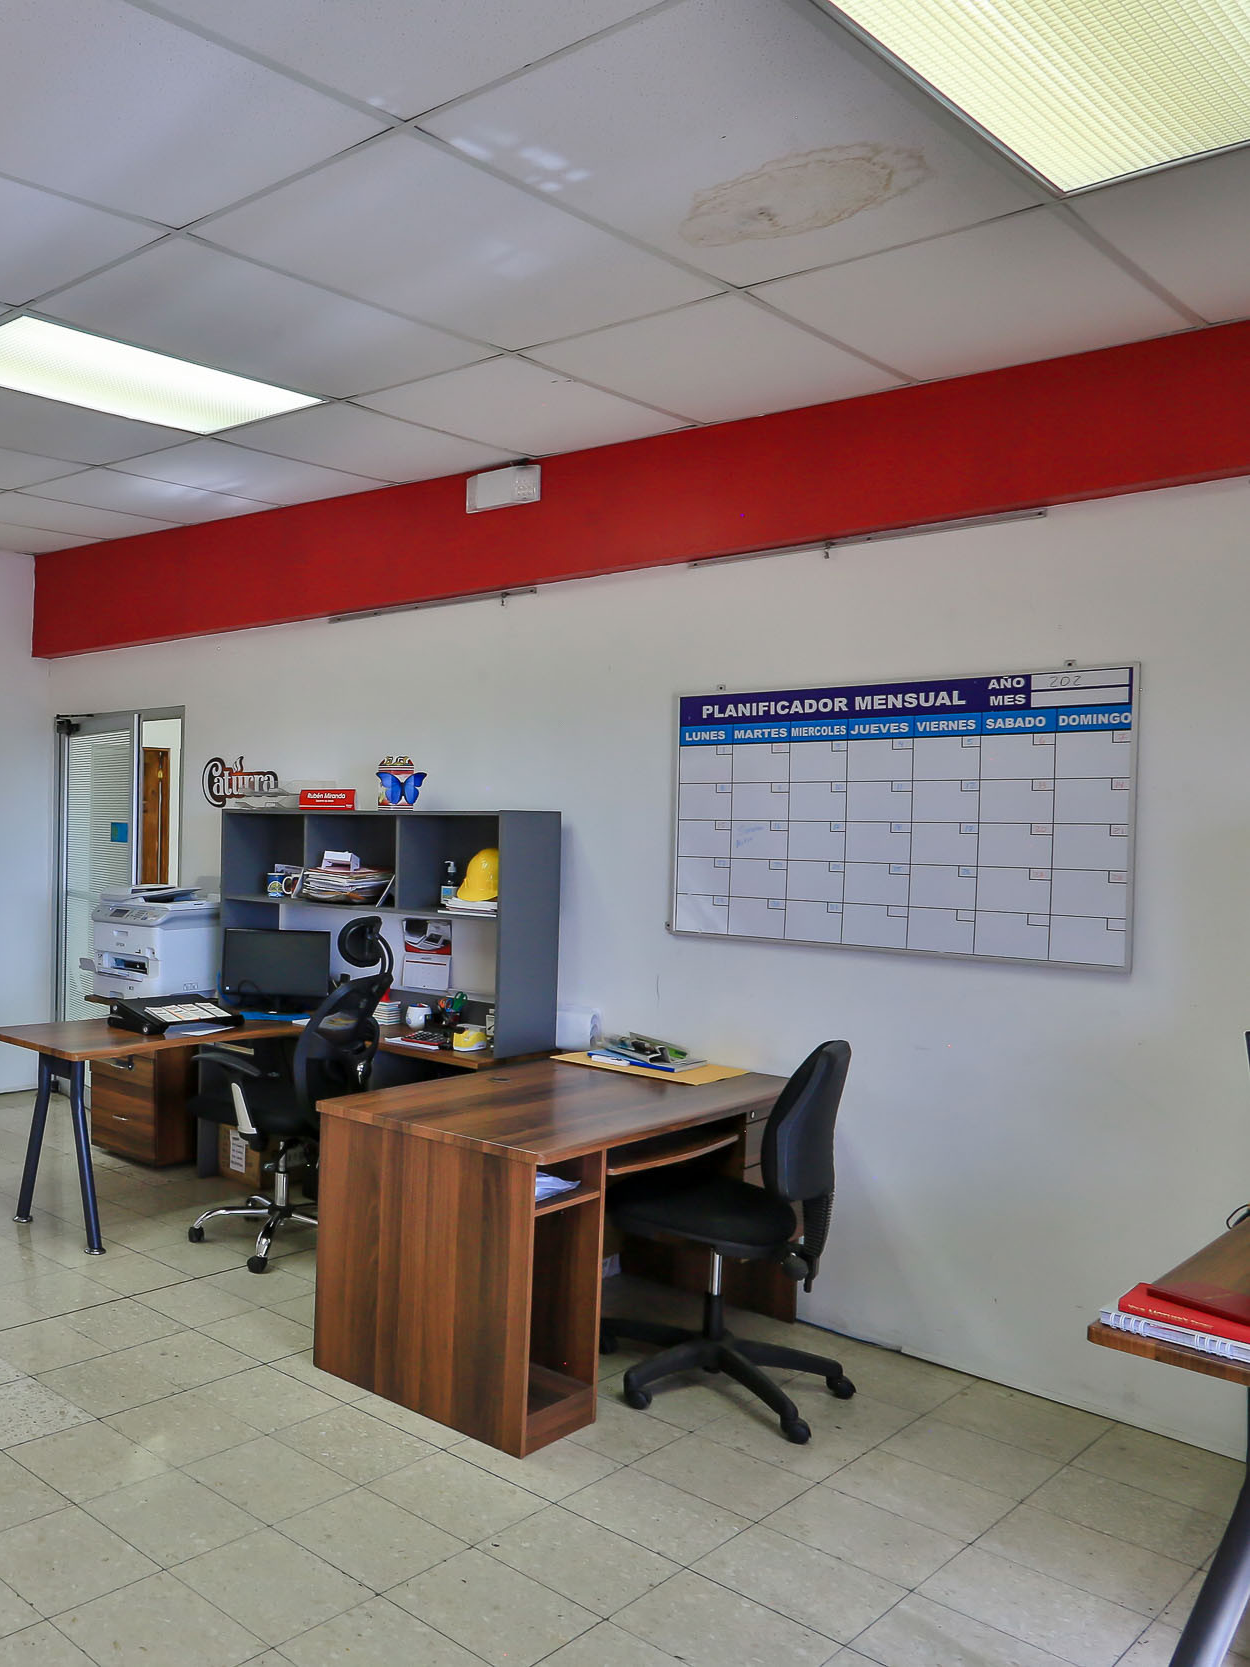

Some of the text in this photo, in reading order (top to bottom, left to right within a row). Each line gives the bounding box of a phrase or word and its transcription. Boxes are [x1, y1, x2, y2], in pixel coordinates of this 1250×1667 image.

[987, 675, 1026, 690] AÑO
[701, 690, 967, 719] PLANIFICADOR MENSUAL
[989, 693, 1027, 707] MES
[685, 712, 1132, 742] LUNES MARTES MIERCOLES JUEVES VIERNES SABADO DOMINGO
[203, 759, 276, 806] Caturra
